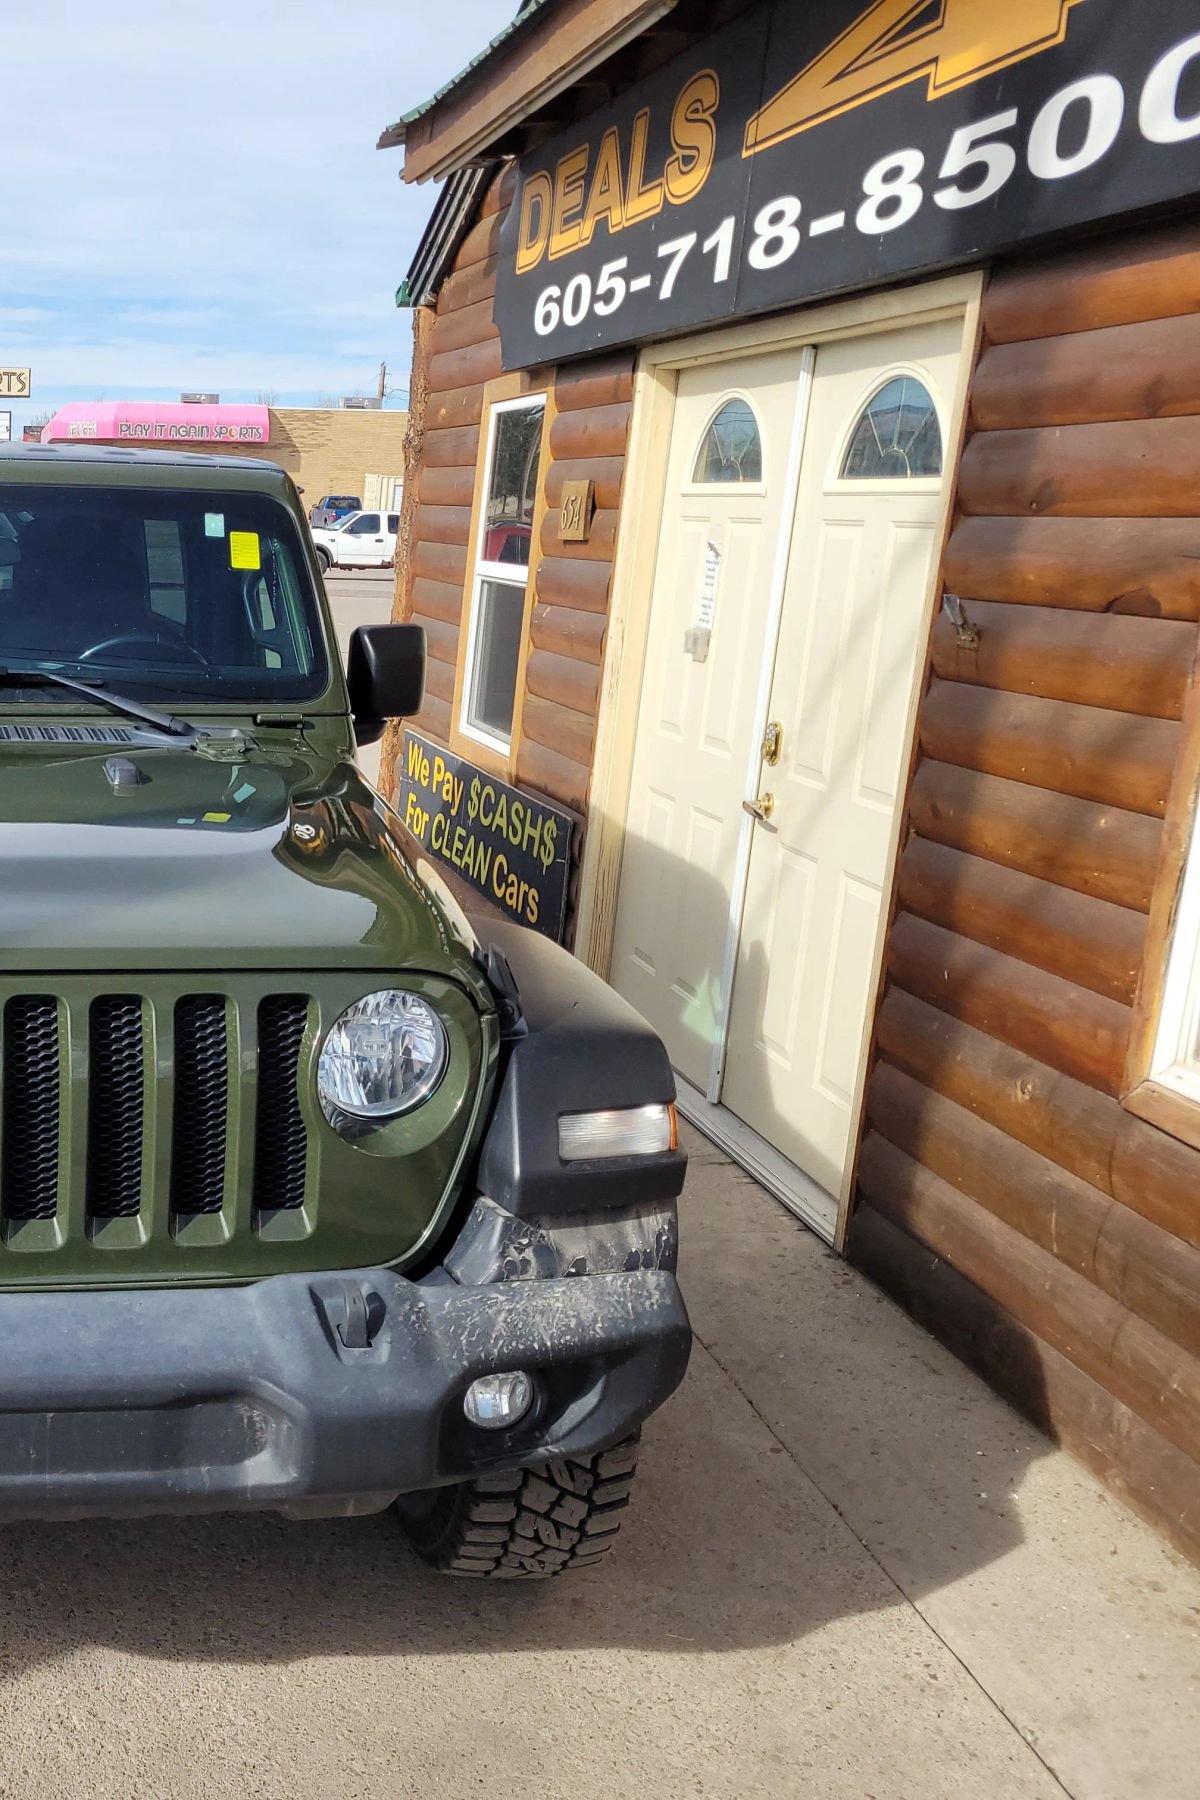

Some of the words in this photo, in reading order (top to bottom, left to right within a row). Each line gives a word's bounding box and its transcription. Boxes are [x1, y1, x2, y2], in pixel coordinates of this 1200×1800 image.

[516, 68, 720, 275] DEALS
[119, 424, 150, 437] PLAY
[154, 424, 166, 437] IT
[169, 425, 209, 438] AGAIN
[213, 425, 263, 440] SPORTS
[561, 495, 582, 530] 654
[406, 792, 430, 839] For
[431, 812, 492, 885] CLEAN
[493, 854, 540, 923] Cars
[408, 740, 429, 787] We
[432, 756, 464, 816] Pay
[467, 774, 557, 875] $CASH$
